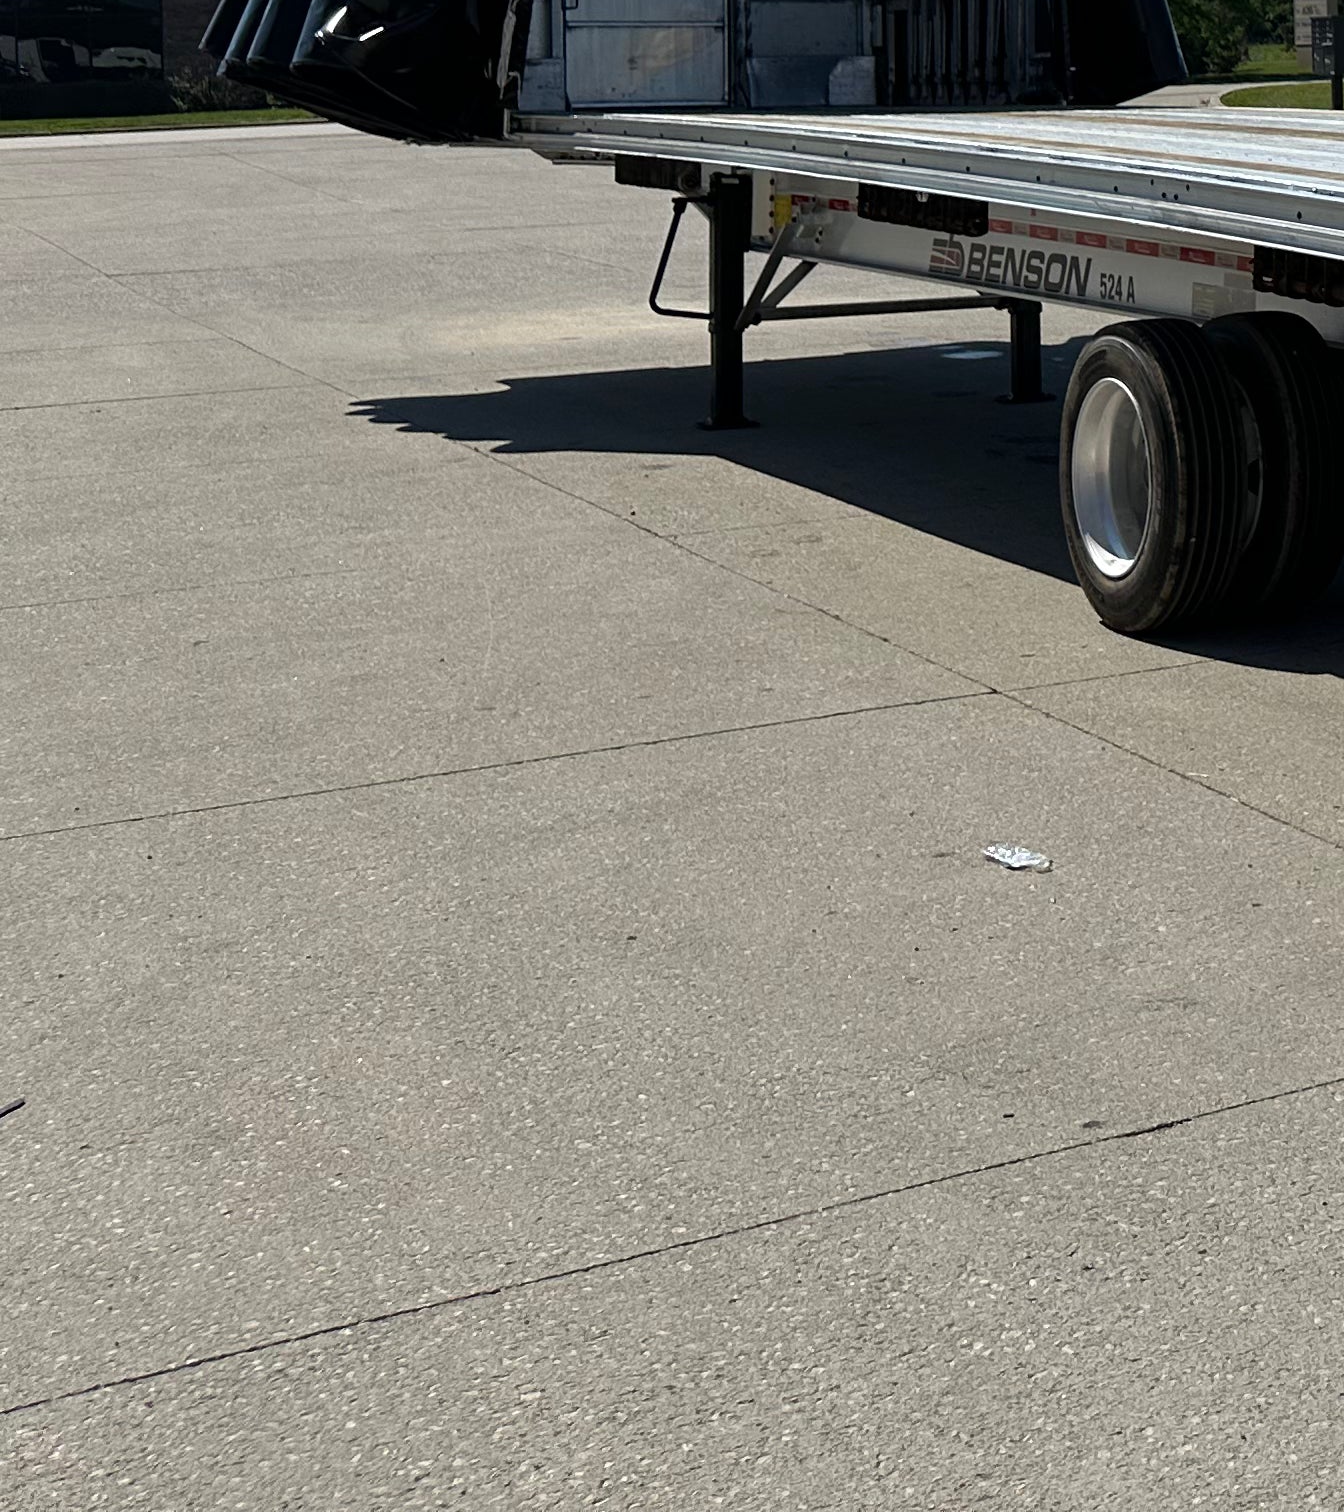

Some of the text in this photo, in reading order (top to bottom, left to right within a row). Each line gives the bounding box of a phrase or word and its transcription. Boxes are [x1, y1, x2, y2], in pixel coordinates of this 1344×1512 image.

[965, 242, 1136, 304] BENSON 524 A
